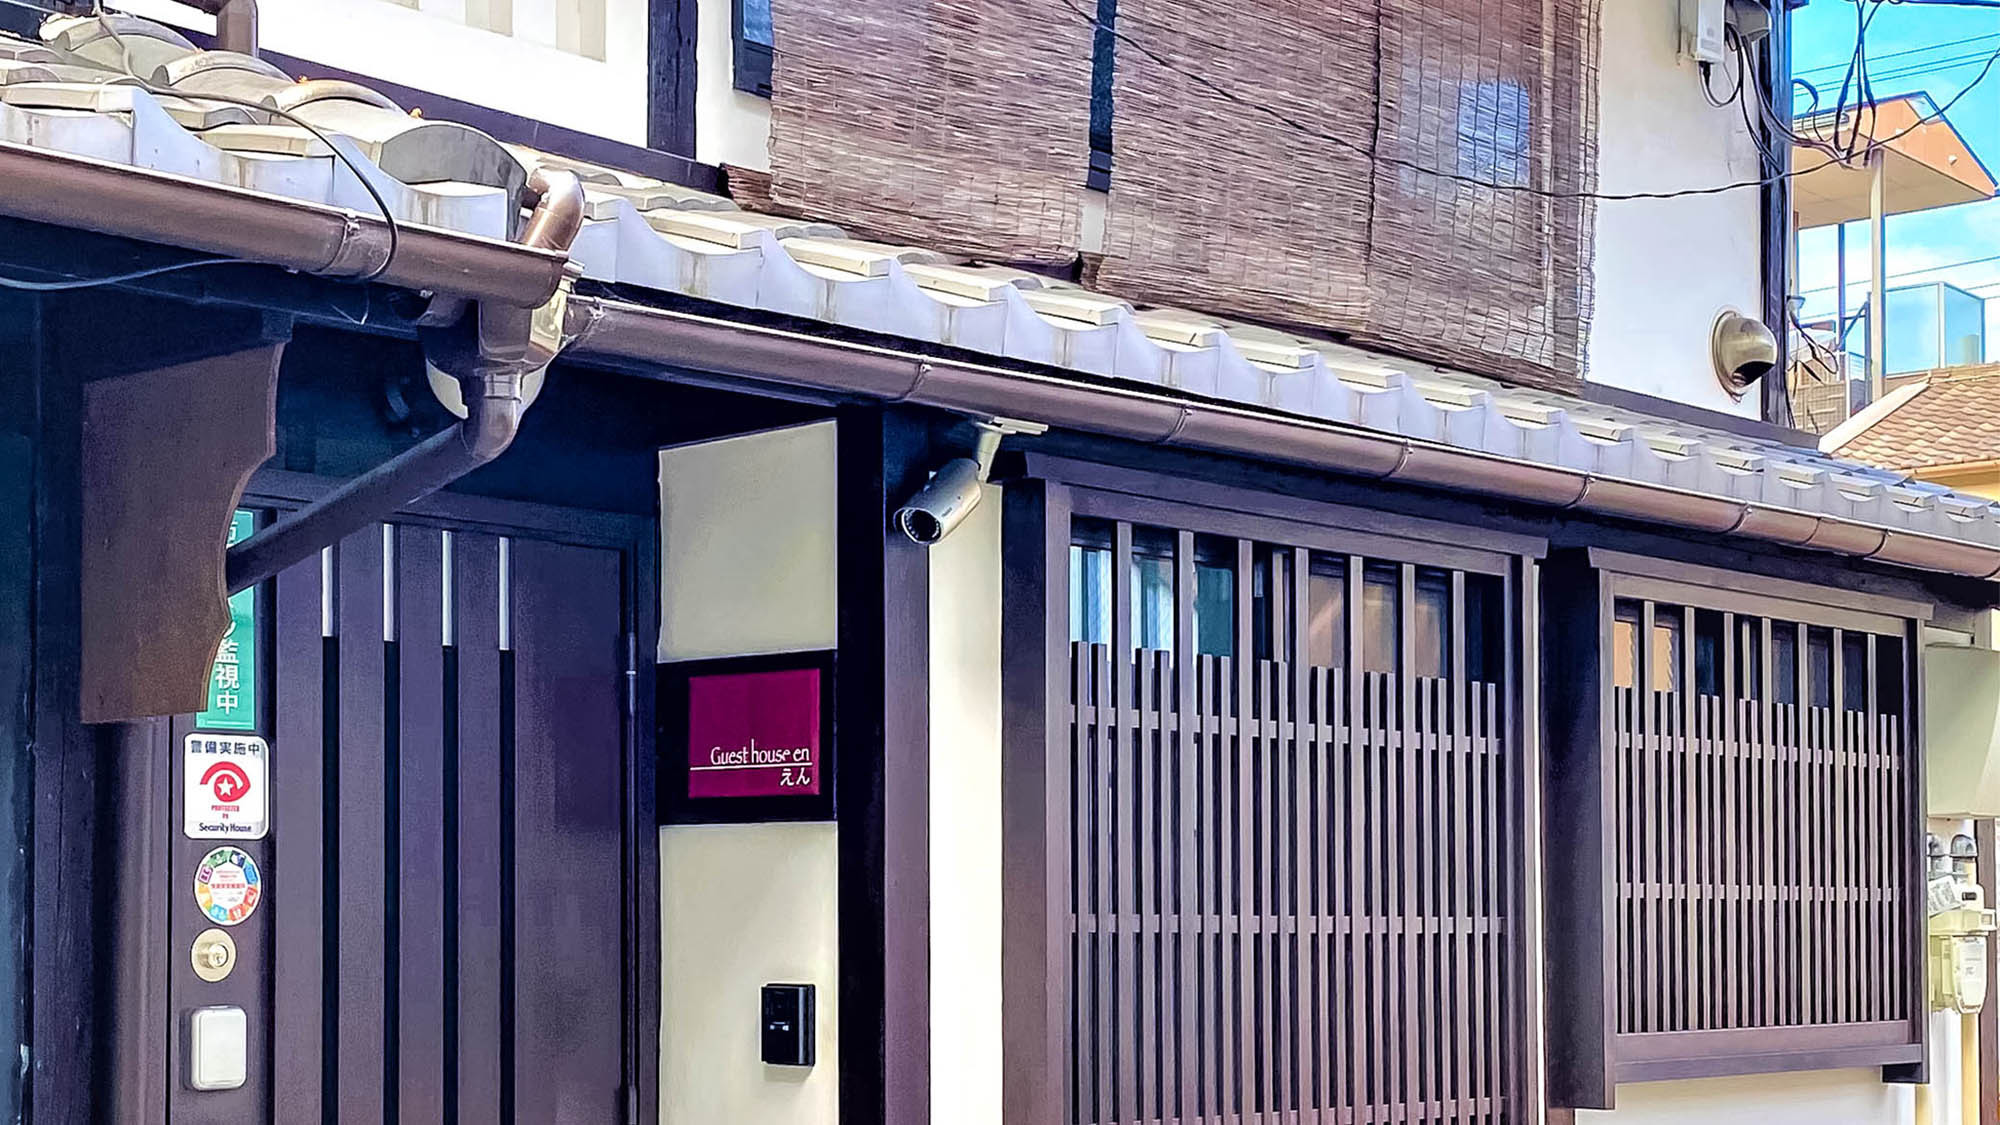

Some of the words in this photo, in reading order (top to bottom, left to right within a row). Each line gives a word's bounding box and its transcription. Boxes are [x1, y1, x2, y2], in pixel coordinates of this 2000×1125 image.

[710, 746, 749, 765] Guest
[751, 738, 791, 763] house
[792, 748, 810, 761] en
[780, 767, 811, 786] えん
[199, 822, 229, 834] Security
[230, 823, 252, 832] House
